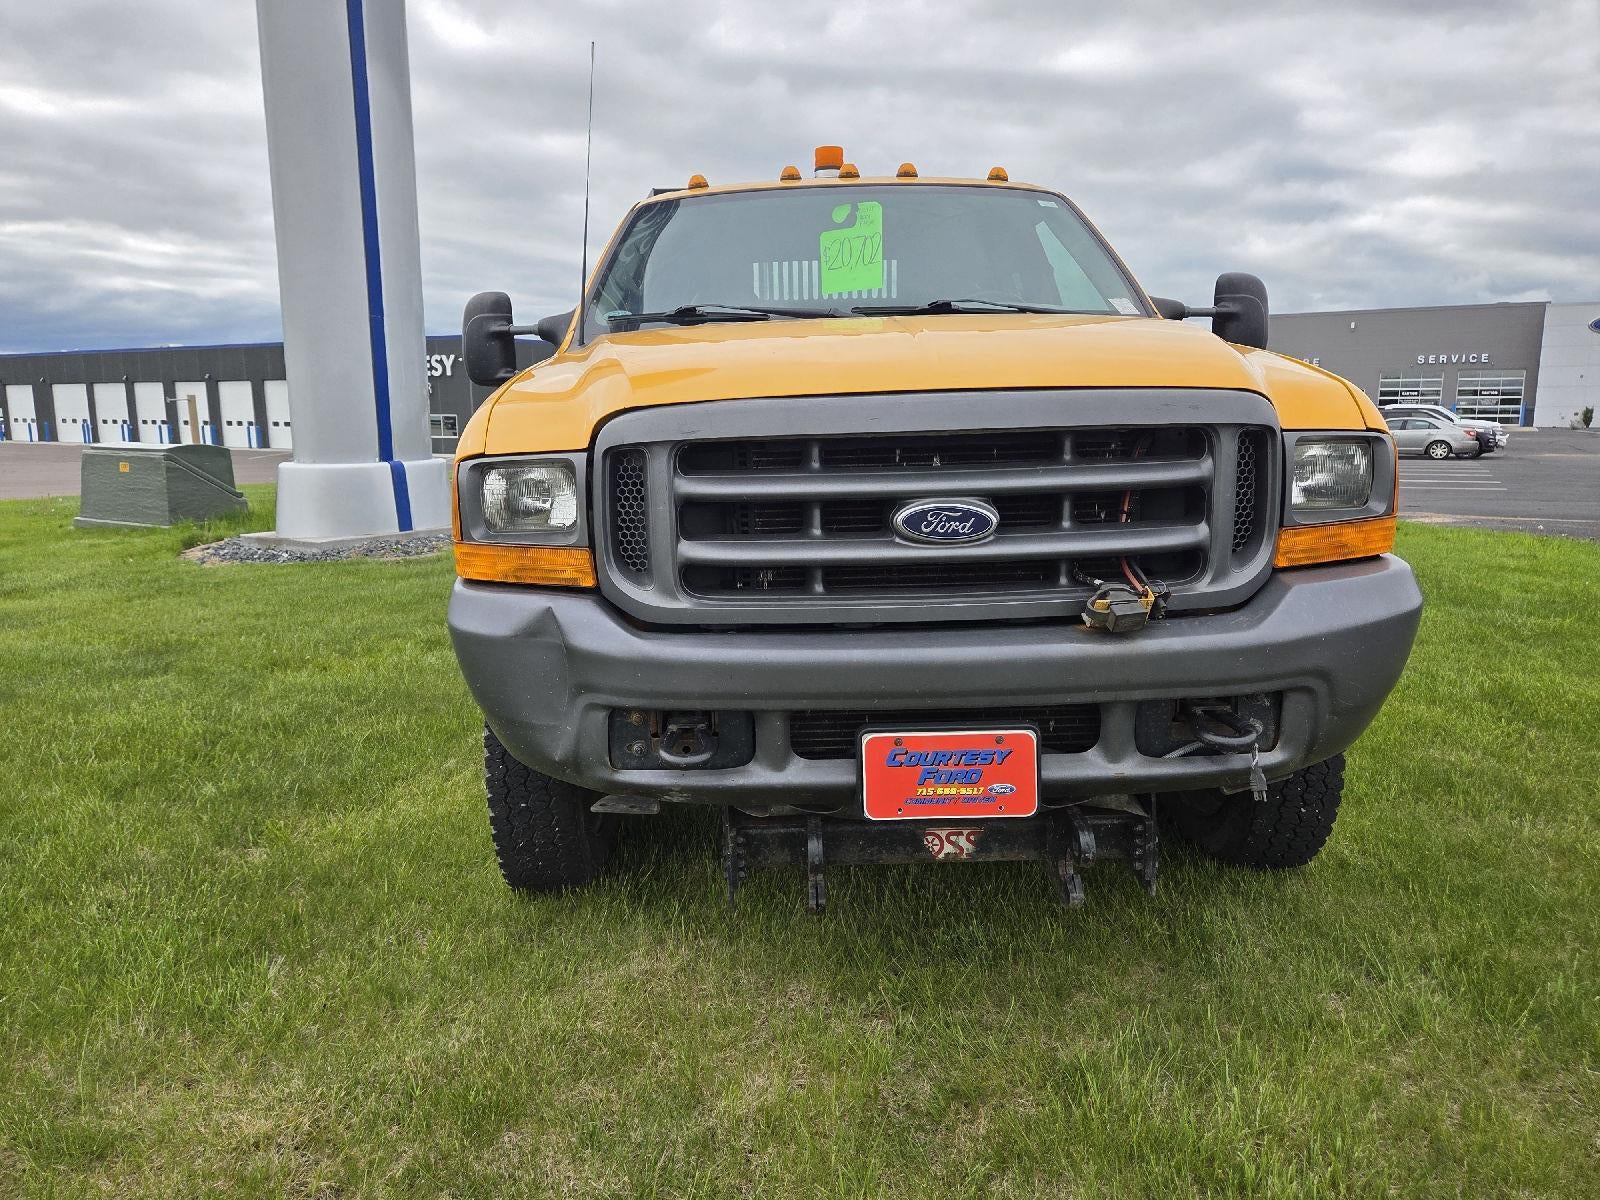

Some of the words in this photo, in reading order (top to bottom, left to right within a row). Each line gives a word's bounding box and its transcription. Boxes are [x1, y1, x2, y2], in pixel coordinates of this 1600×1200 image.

[1417, 353, 1489, 364] SERVICE
[921, 510, 975, 534] Ford
[885, 747, 1014, 768] COURTESY
[917, 767, 984, 786] FORD
